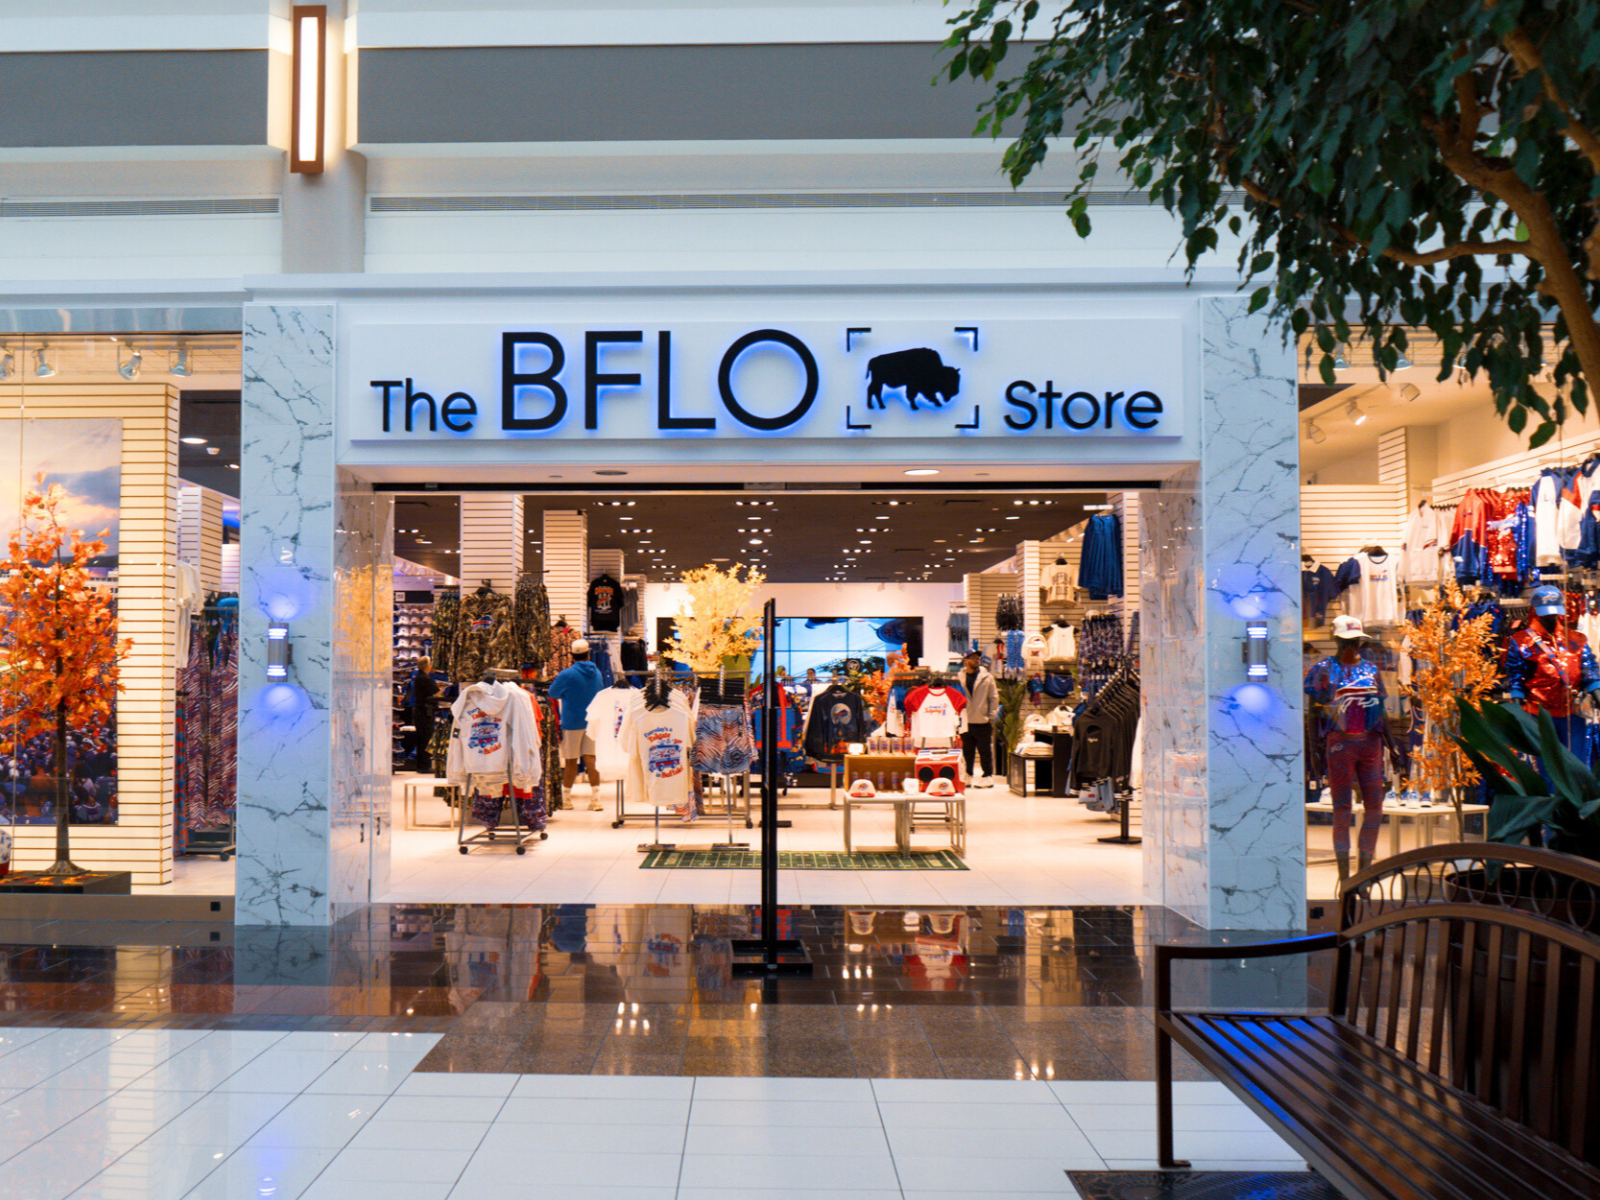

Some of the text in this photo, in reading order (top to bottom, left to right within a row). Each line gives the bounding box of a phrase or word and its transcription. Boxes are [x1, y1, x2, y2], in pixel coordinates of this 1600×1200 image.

[370, 328, 1163, 433] The BFLO Store
